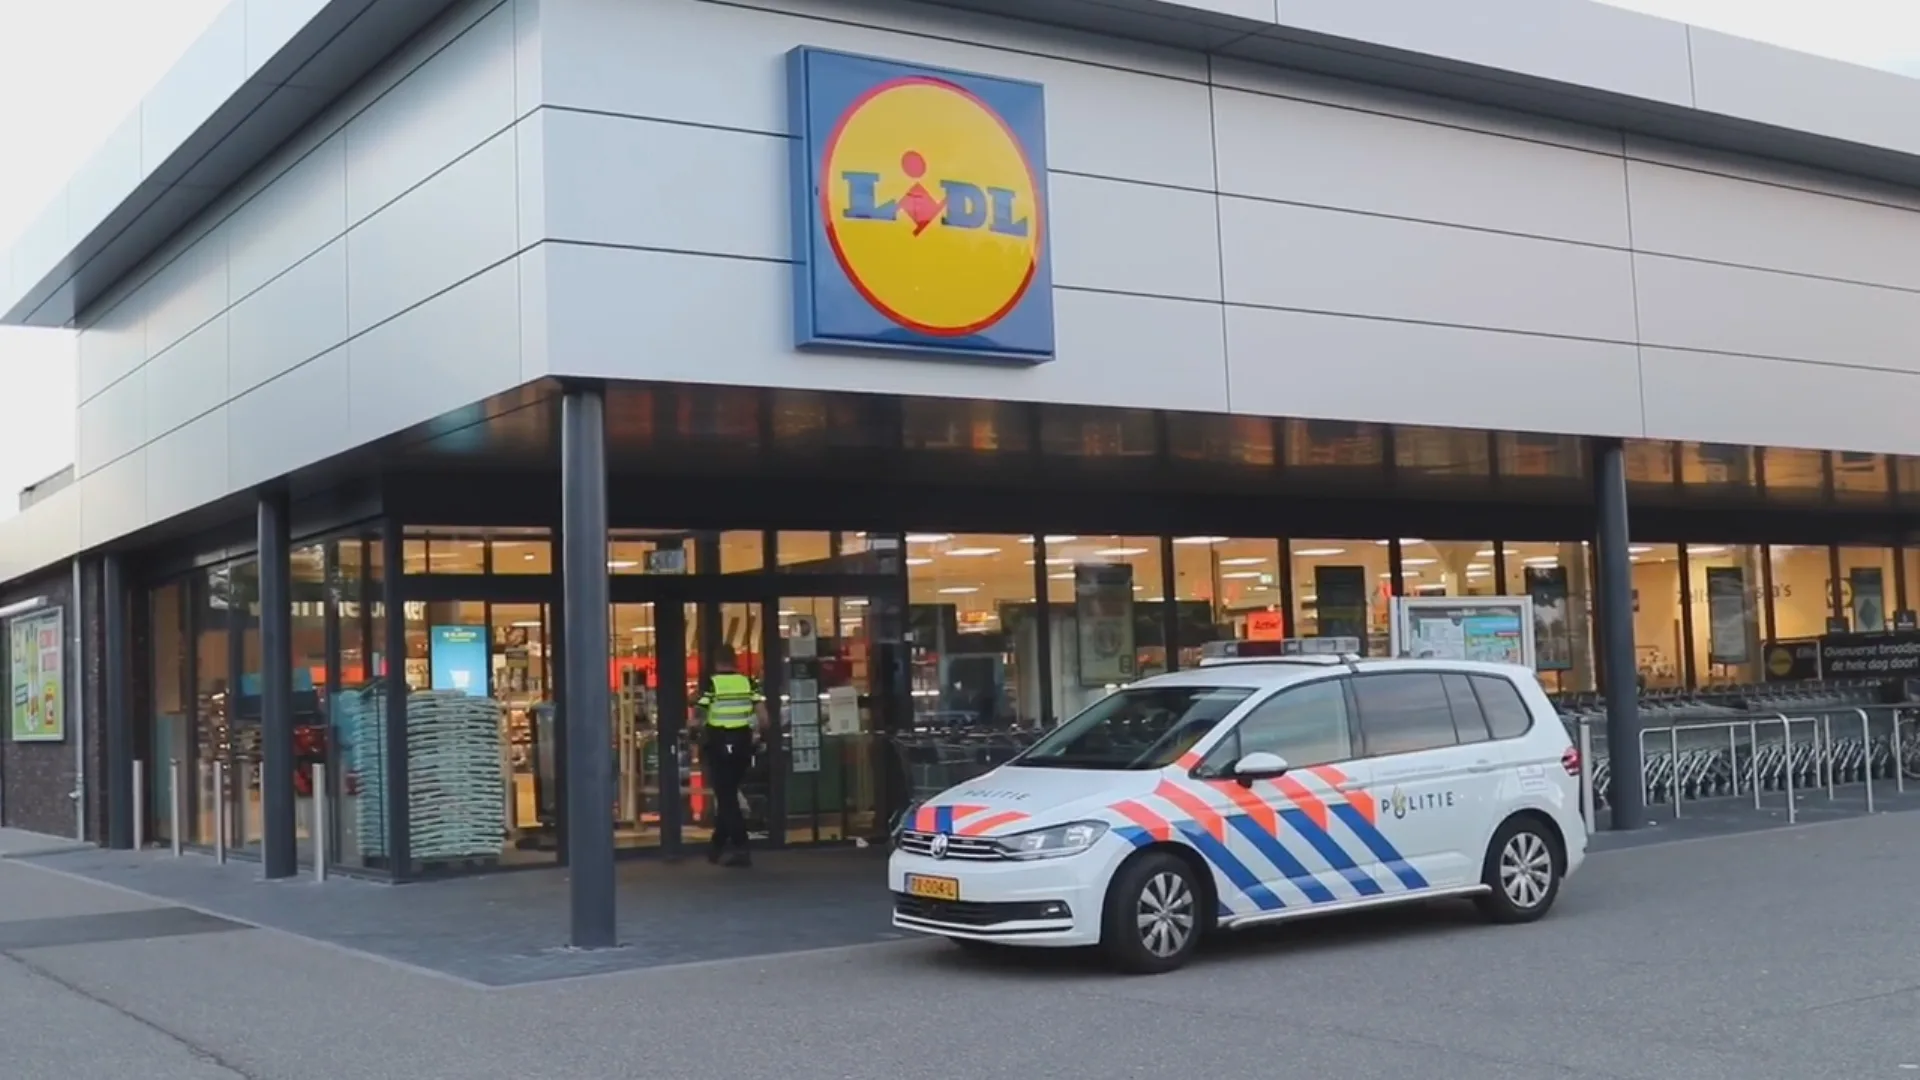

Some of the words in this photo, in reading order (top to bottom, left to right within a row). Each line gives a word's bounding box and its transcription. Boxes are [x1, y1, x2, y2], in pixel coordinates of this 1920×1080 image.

[1879, 642, 1920, 655] broodje
[1868, 659, 1889, 672] dag
[1382, 790, 1455, 820] POLITIE
